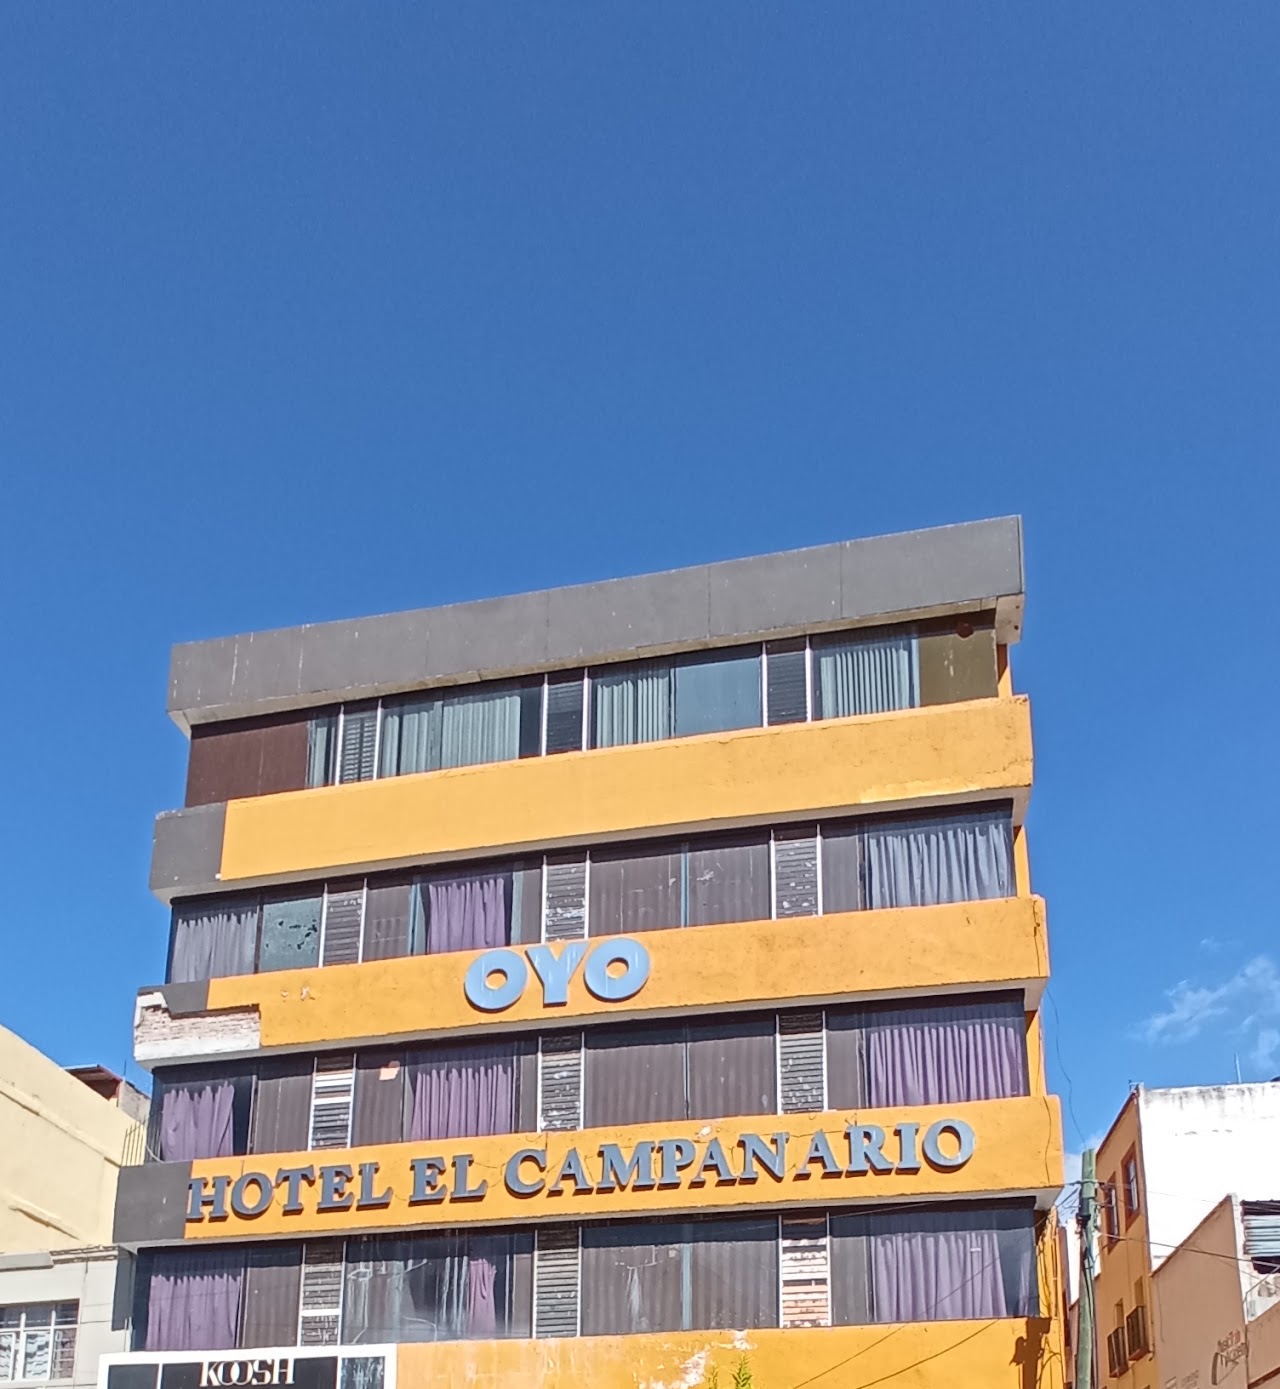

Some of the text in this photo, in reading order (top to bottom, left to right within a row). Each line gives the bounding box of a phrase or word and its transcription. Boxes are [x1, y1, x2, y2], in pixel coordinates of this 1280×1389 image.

[464, 937, 651, 1013] OYO
[186, 1118, 977, 1223] HOTEL EL CAMPANARIO
[200, 1358, 295, 1388] KOOSH
